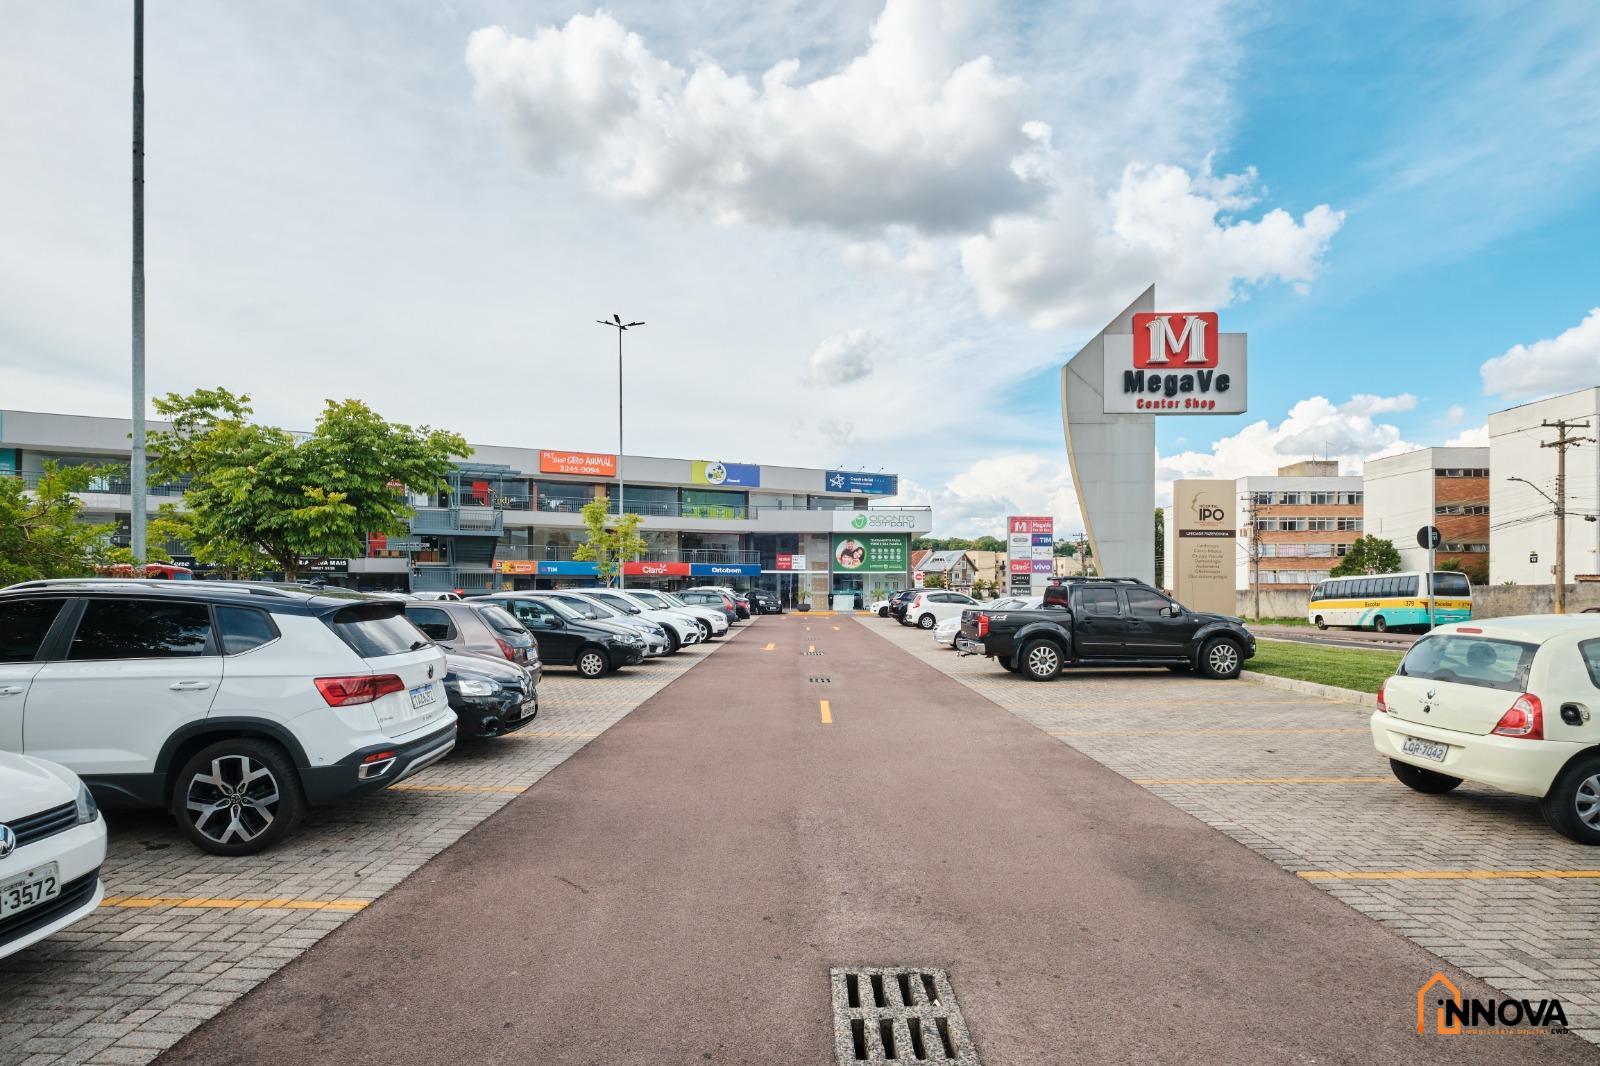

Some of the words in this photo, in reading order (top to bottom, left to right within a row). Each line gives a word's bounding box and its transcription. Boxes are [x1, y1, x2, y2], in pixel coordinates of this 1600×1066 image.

[1145, 314, 1209, 364] M
[1123, 369, 1231, 398] MegaVe
[1136, 398, 1180, 410] Center
[1184, 397, 1216, 411] Shop
[585, 456, 614, 467] ANIMAL
[1199, 508, 1225, 521] IPO
[1039, 536, 1052, 544] TIM
[642, 566, 665, 574] Claro
[1011, 563, 1029, 571] Claro
[1034, 563, 1051, 571] vivo
